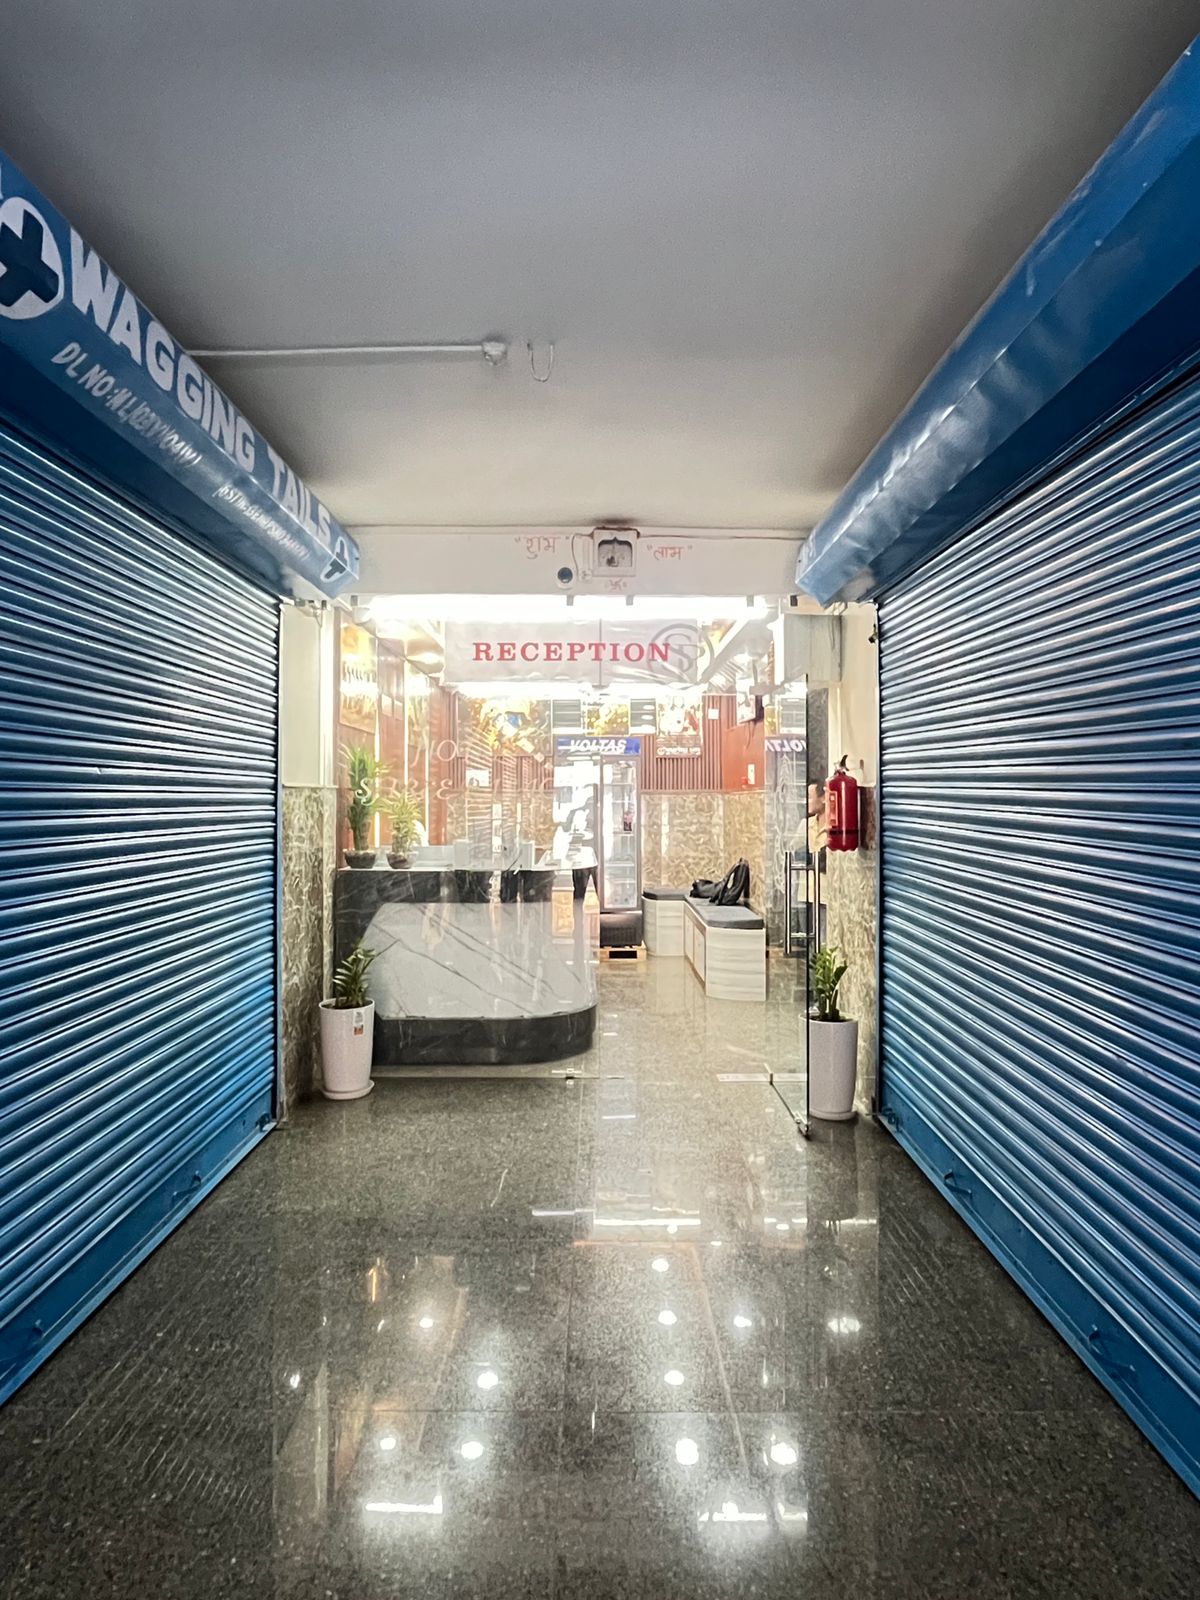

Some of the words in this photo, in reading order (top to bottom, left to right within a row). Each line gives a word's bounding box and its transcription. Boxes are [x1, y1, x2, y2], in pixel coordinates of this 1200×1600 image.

[50, 342, 88, 378] DL
[70, 226, 255, 473] WAGGING
[267, 444, 332, 552] TAILS
[472, 642, 671, 662] RECEPTION
[569, 739, 627, 753] VOLTAS
